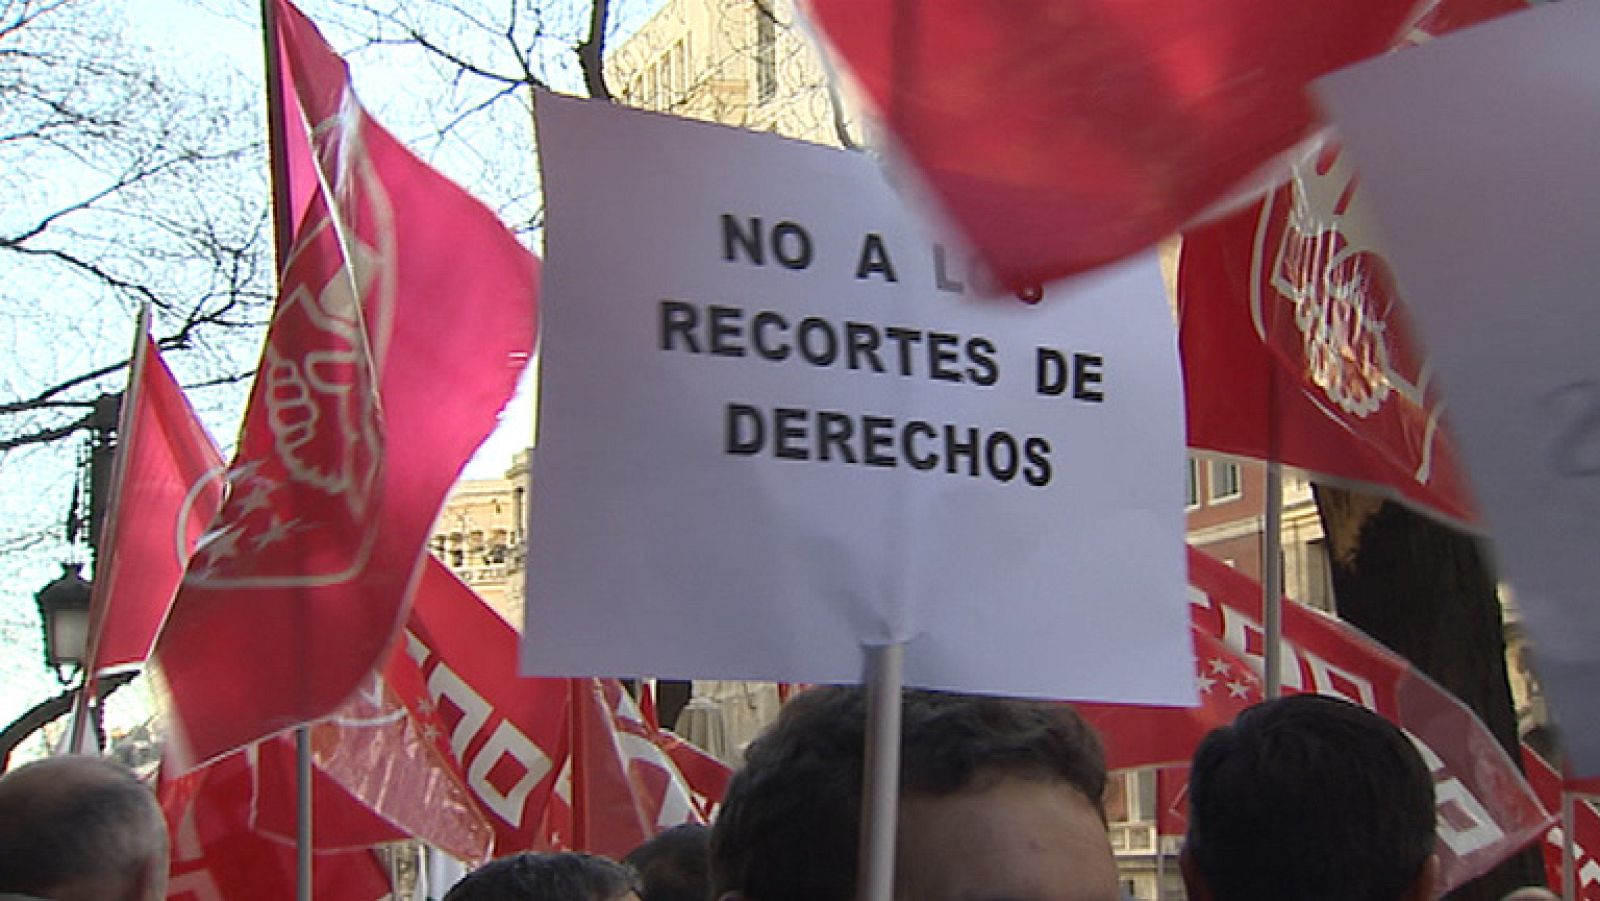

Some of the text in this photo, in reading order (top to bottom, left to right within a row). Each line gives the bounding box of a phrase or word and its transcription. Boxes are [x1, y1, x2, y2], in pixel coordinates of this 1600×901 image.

[719, 212, 814, 271] NO
[854, 232, 899, 284] A
[658, 298, 1105, 404] RECORTES DE
[723, 401, 1053, 487] DERECHOS
